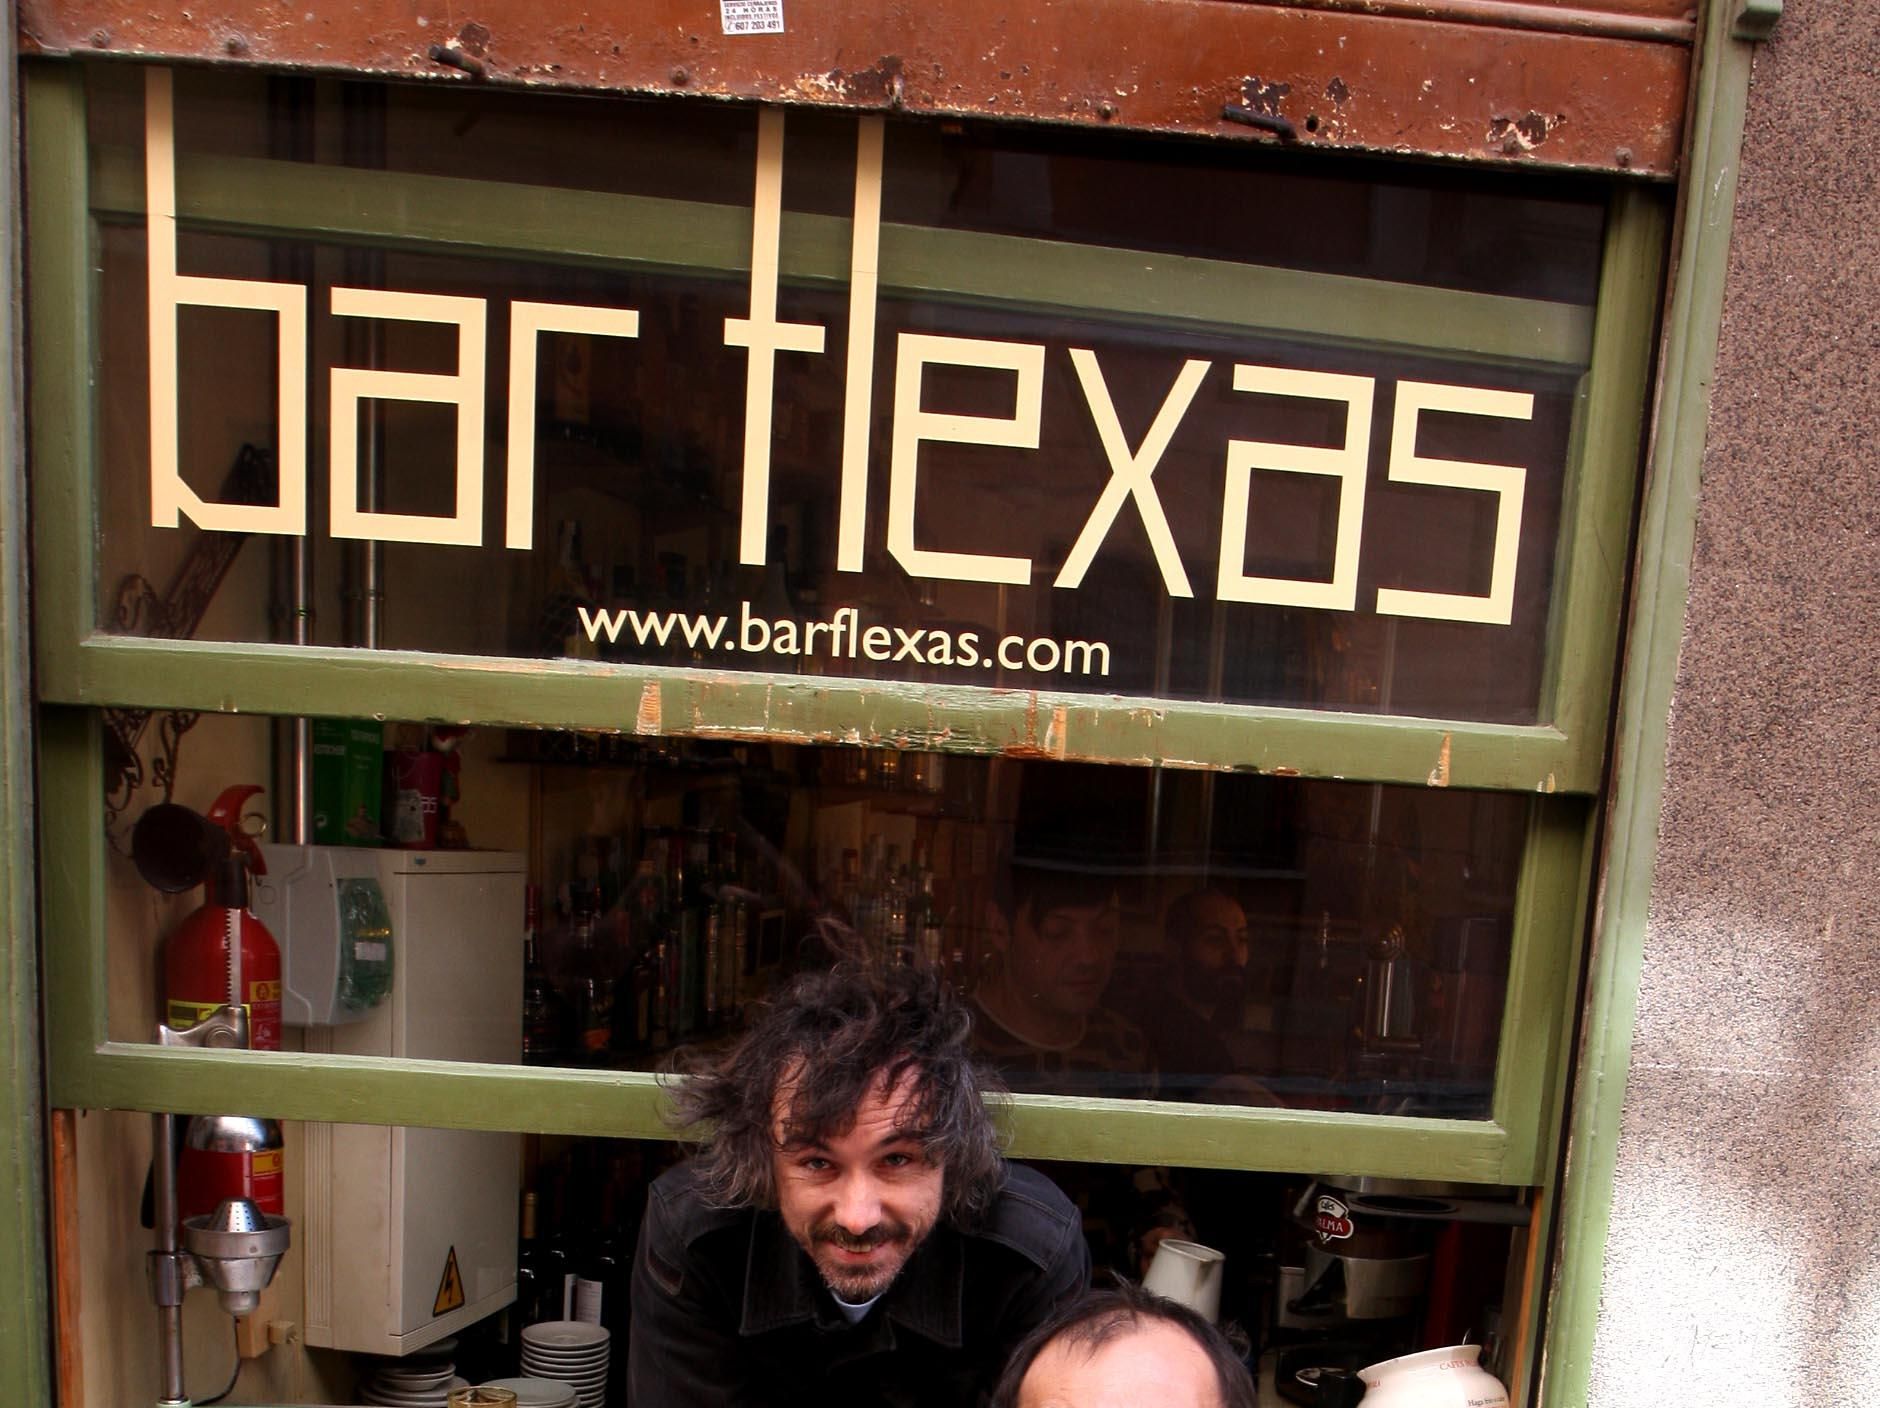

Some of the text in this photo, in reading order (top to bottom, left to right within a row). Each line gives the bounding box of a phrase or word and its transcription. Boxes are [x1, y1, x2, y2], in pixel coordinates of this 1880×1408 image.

[735, 21, 749, 30] 607
[751, 21, 765, 30] 203
[145, 65, 1535, 625] bar flexas
[577, 601, 1111, 676] www.barflexas.com
